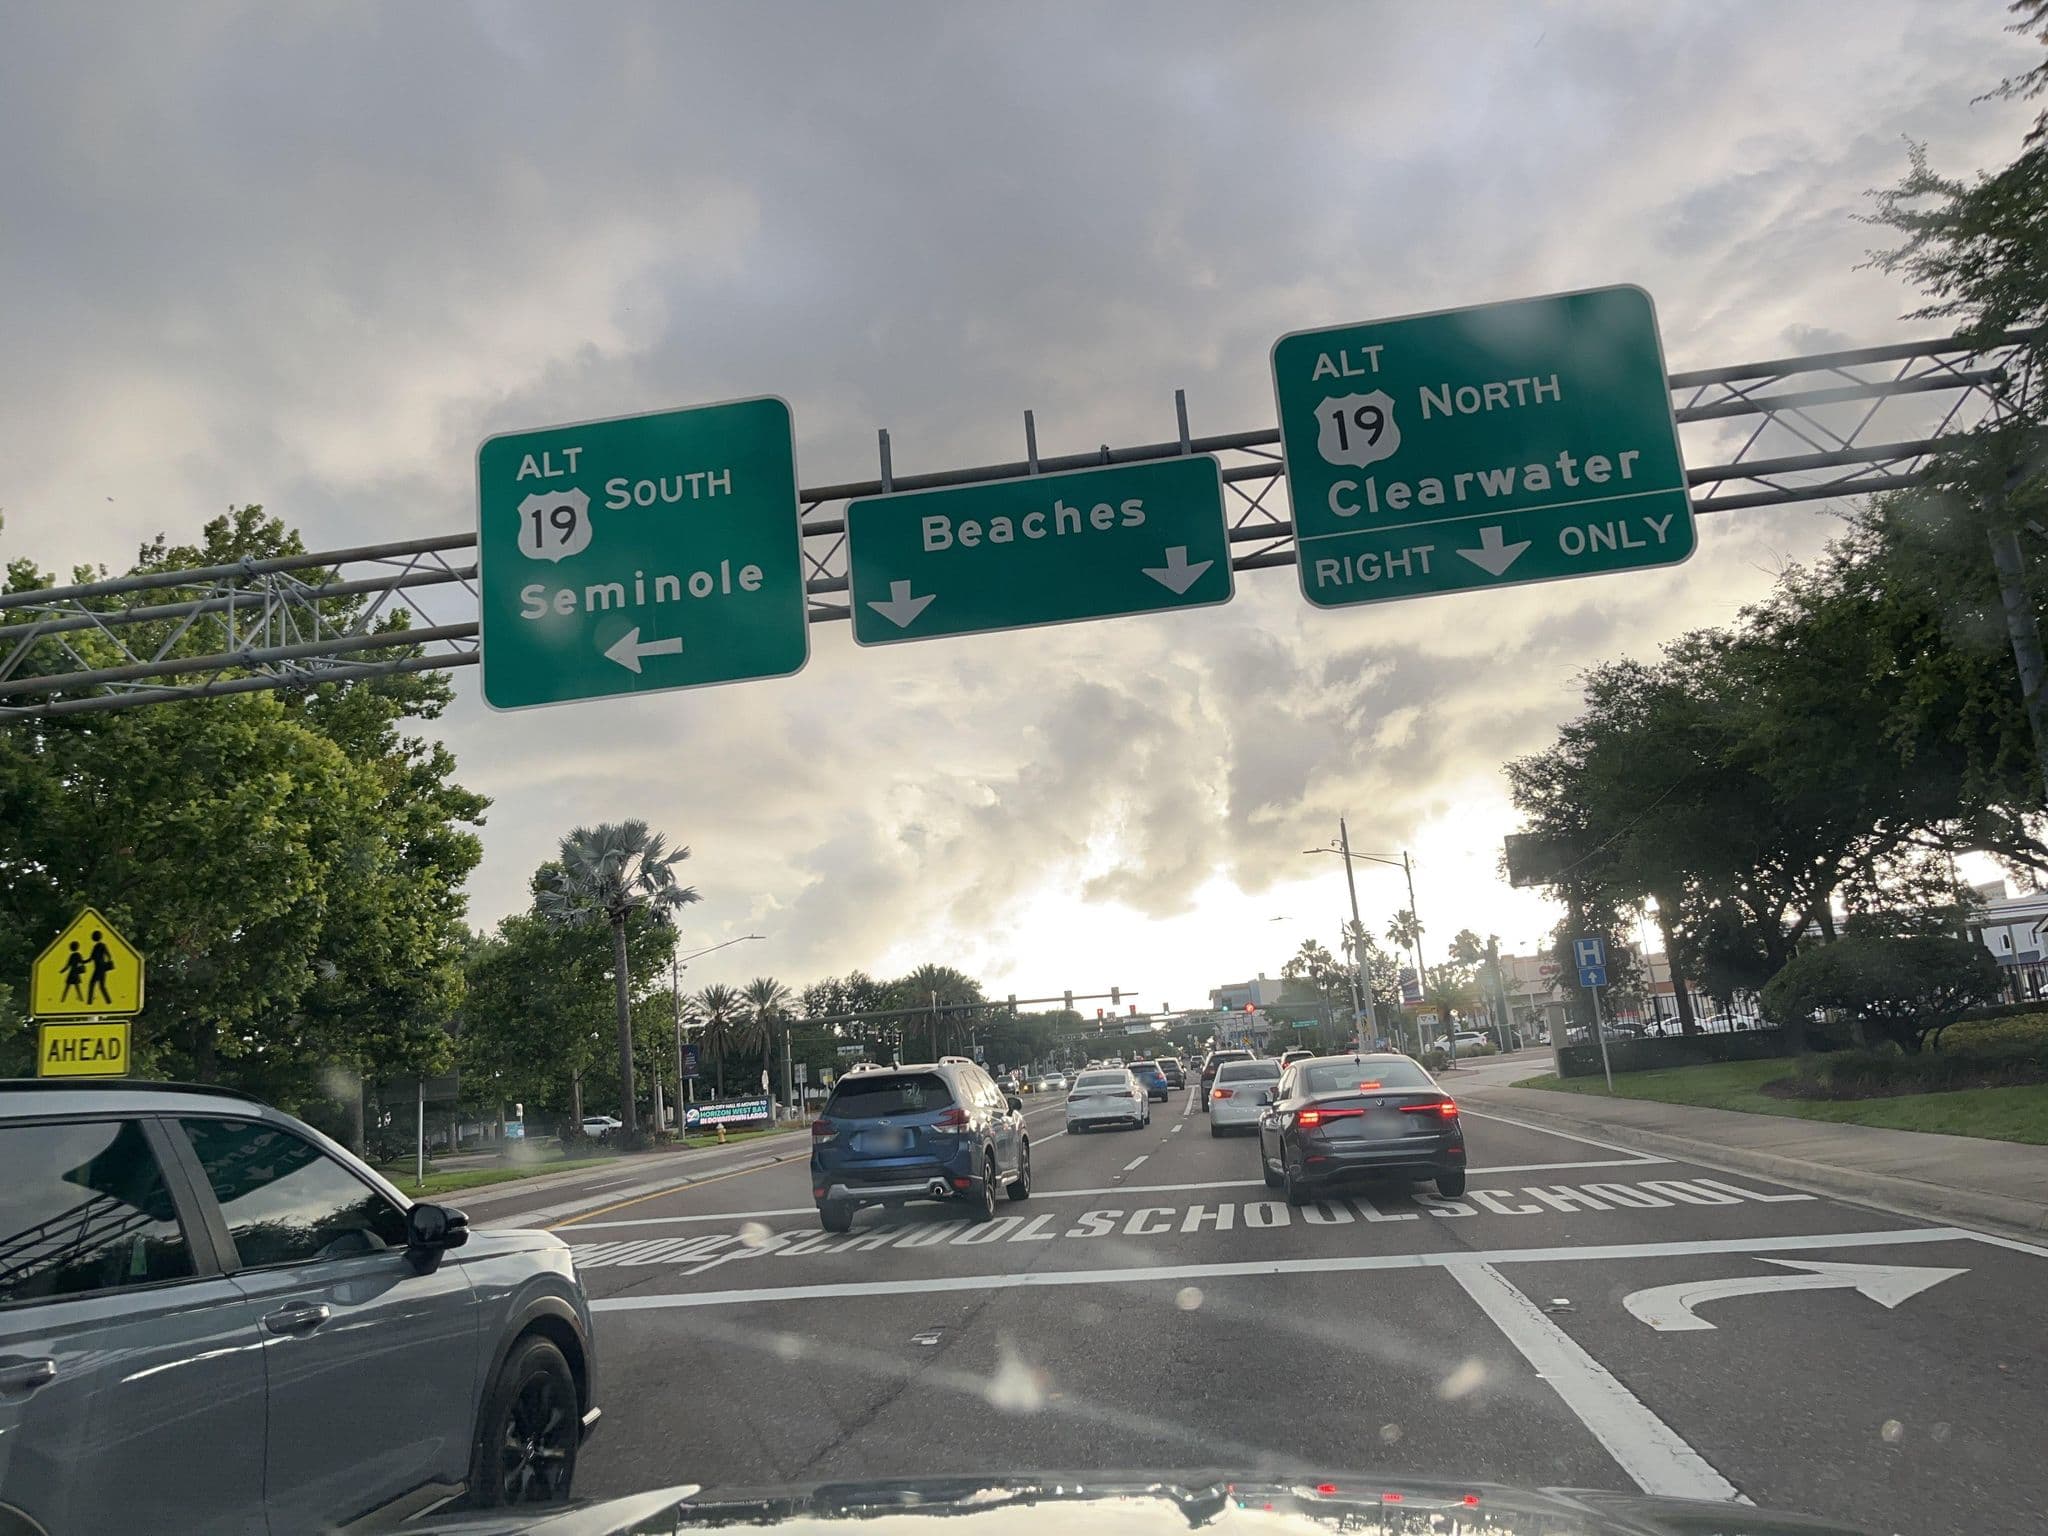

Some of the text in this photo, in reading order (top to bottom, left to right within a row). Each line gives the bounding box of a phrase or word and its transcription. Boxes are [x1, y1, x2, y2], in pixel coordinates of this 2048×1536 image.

[1312, 345, 1383, 381] ALT
[1420, 374, 1560, 419] NORTH
[1332, 405, 1384, 451] 19
[517, 447, 582, 480] ALT
[1329, 450, 1640, 516] Clearwater
[605, 469, 732, 509] SOUTH
[531, 506, 577, 549] 19
[921, 499, 1146, 552] Beaches
[1315, 513, 1674, 588] RIGHT ONLY
[519, 560, 764, 619] Seminole
[1577, 940, 1602, 966] H
[47, 1037, 122, 1062] AHEAD
[732, 1107, 751, 1115] WEST
[1416, 1178, 1819, 1218] SCHOOL
[1065, 1199, 1420, 1238] SCHOOL
